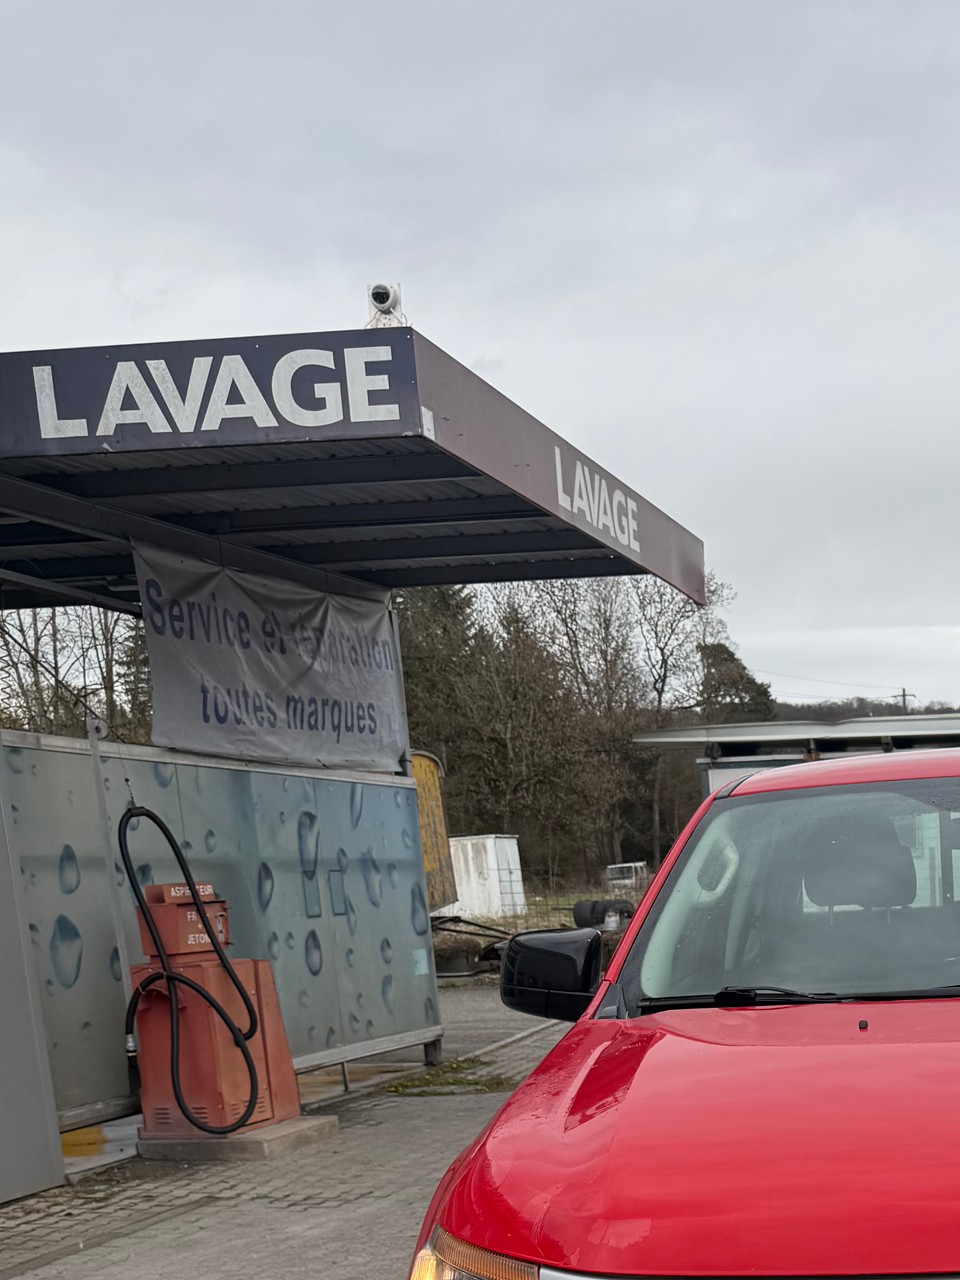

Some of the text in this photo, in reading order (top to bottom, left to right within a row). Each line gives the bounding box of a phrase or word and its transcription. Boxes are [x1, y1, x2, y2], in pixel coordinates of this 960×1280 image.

[32, 345, 400, 439] LAVAGE
[554, 445, 641, 553] LAVAGE
[145, 577, 250, 650] Service
[200, 677, 378, 744] toutes marques
